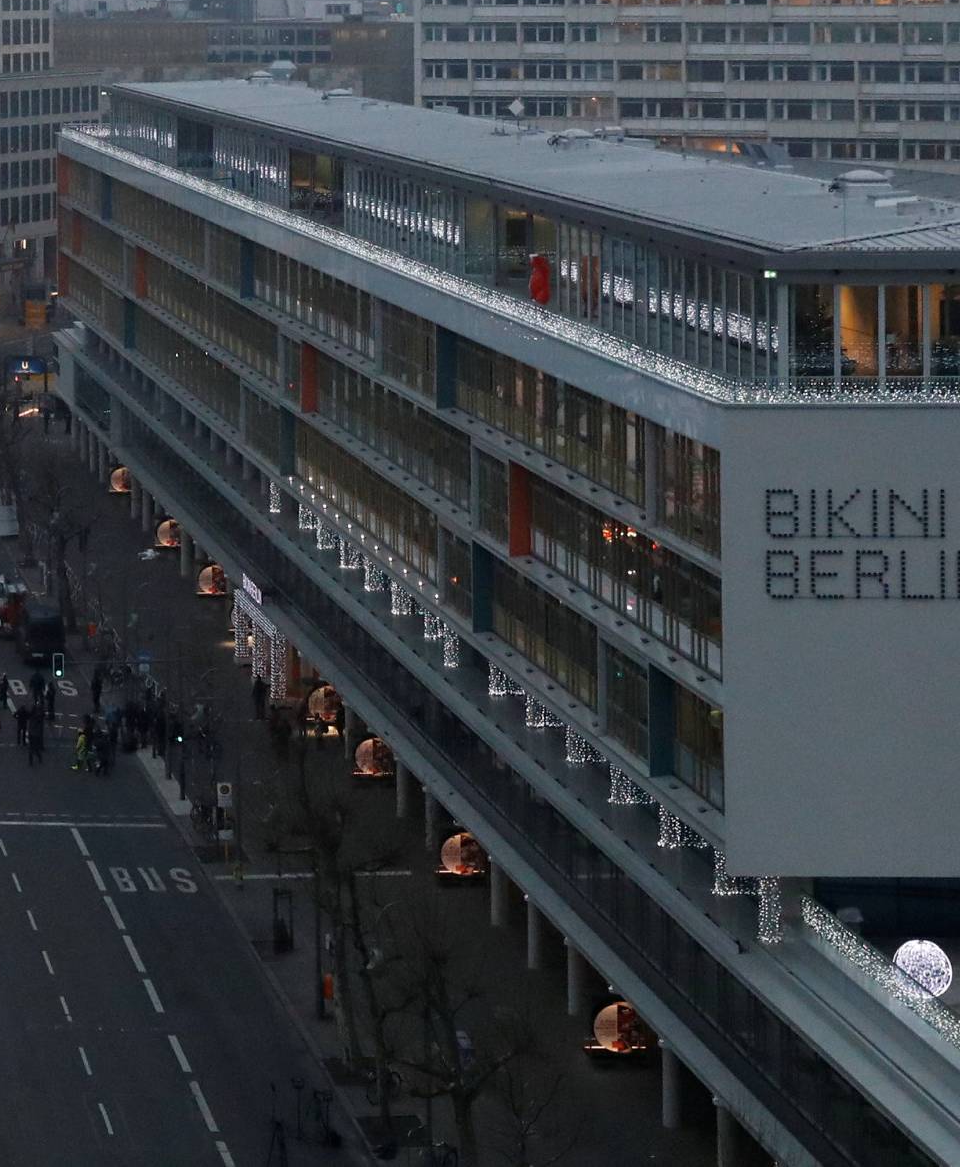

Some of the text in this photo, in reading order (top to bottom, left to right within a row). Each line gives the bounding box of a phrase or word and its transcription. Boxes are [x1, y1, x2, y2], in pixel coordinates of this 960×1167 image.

[21, 360, 29, 370] U
[765, 489, 945, 538] BIKINI
[766, 549, 960, 600] BERLI
[7, 679, 79, 697] BS
[108, 866, 199, 894] BUS
